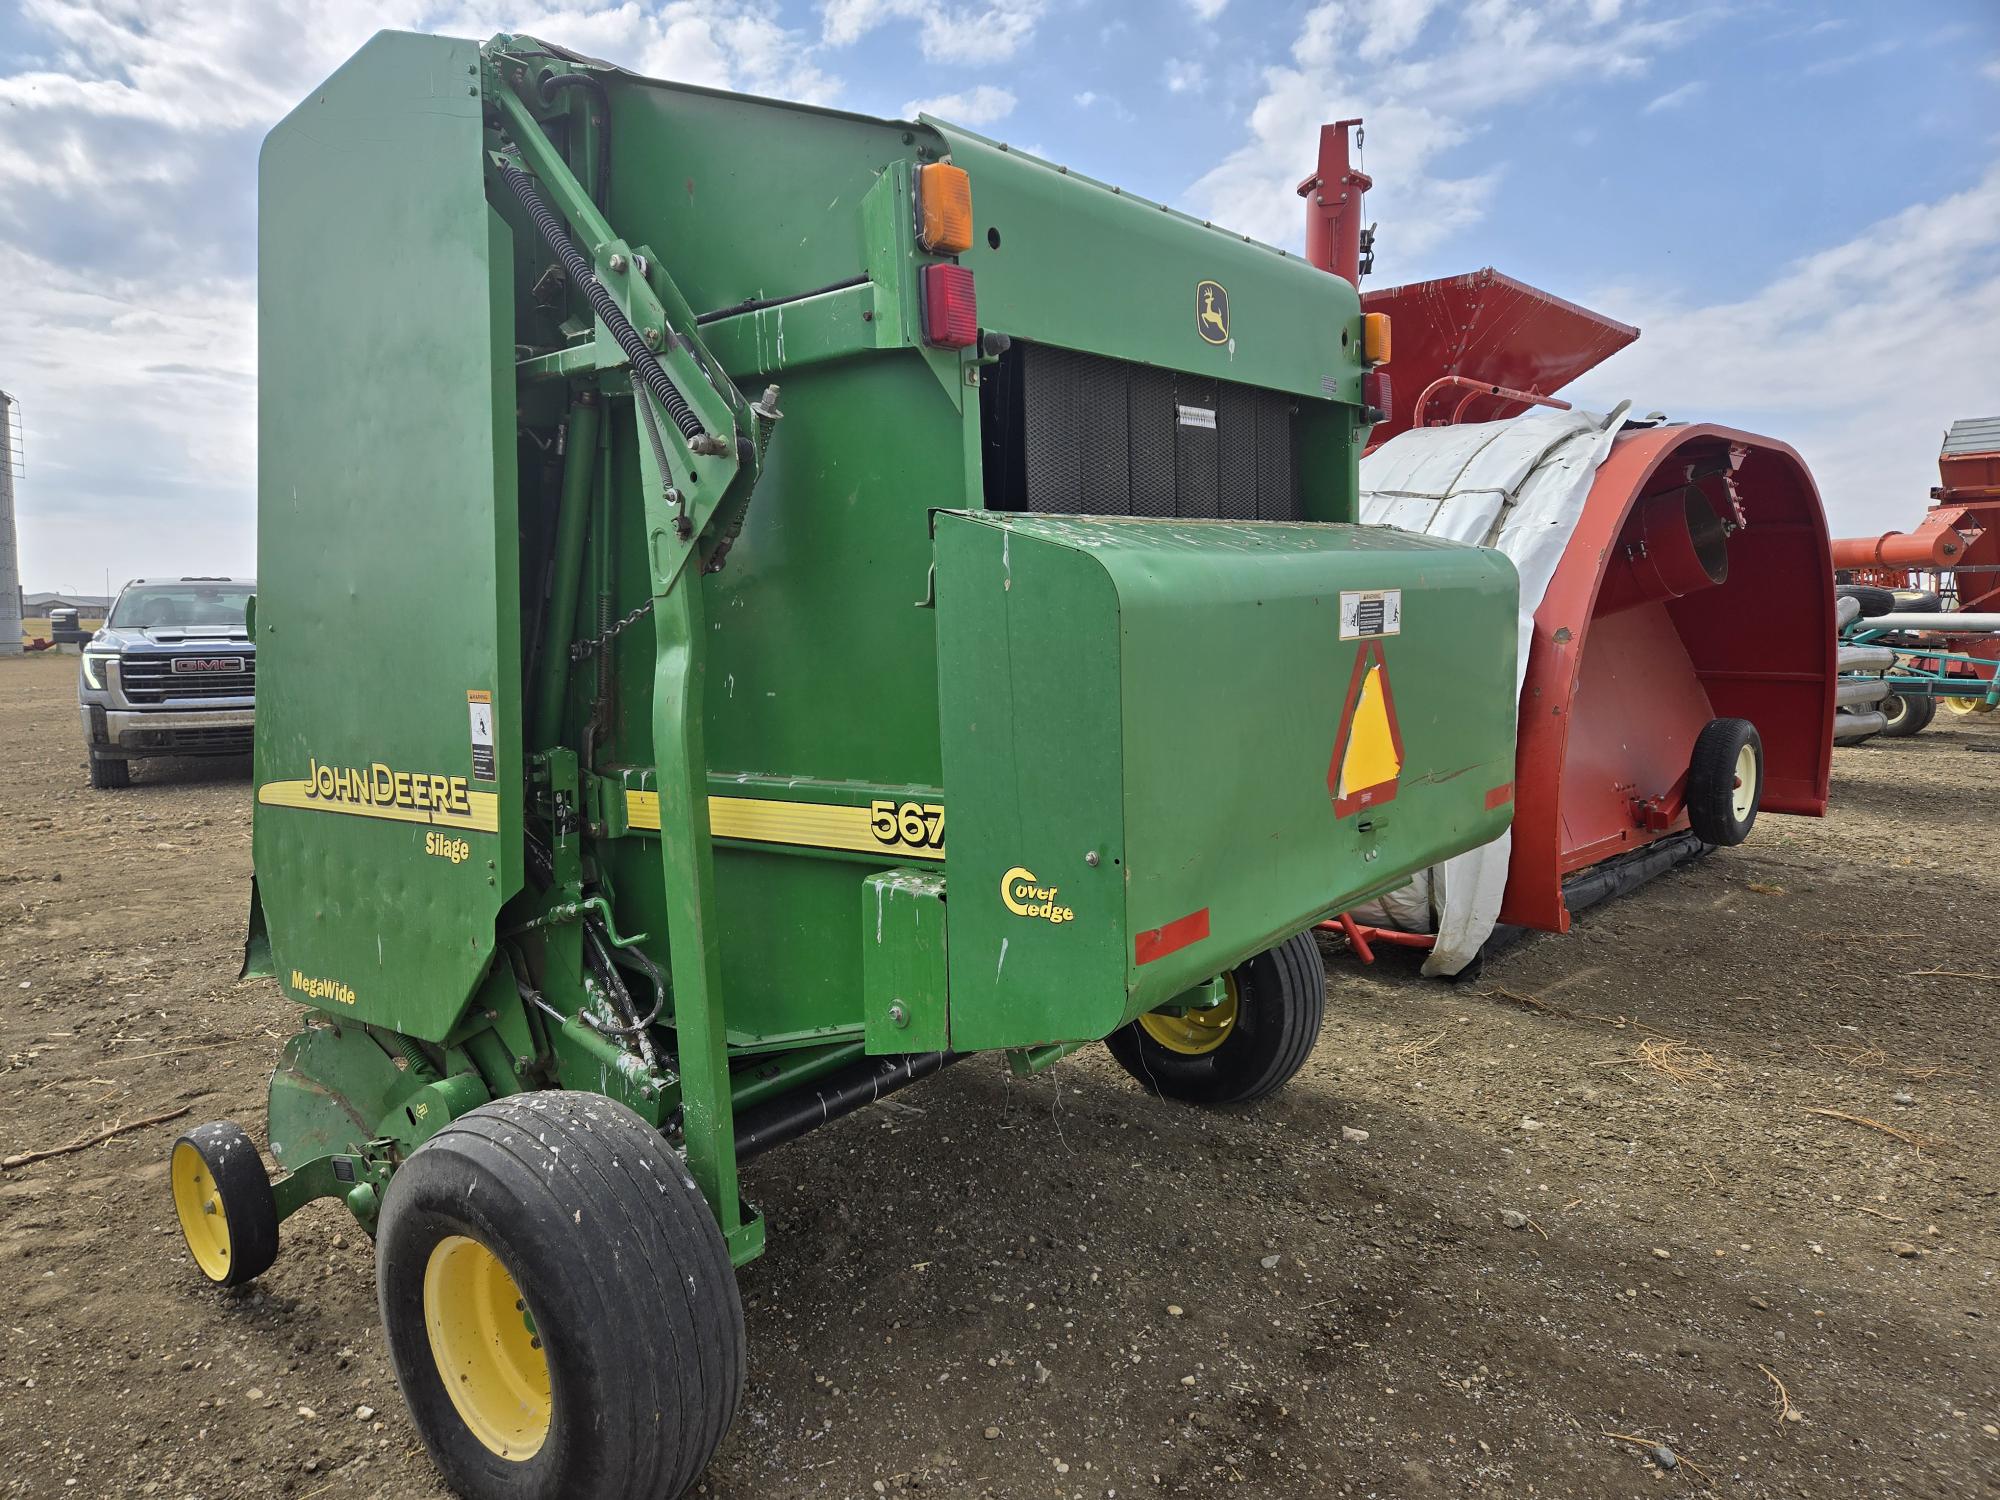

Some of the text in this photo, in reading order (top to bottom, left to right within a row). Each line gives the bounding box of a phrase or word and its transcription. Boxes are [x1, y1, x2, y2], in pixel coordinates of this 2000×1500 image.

[176, 660, 240, 671] GMC
[304, 758, 371, 803] JOHN
[371, 762, 471, 816] DEERE
[871, 800, 944, 848] 567
[425, 830, 470, 864] Silage
[1000, 866, 1058, 916] Cover
[291, 970, 356, 1005] MegaWide
